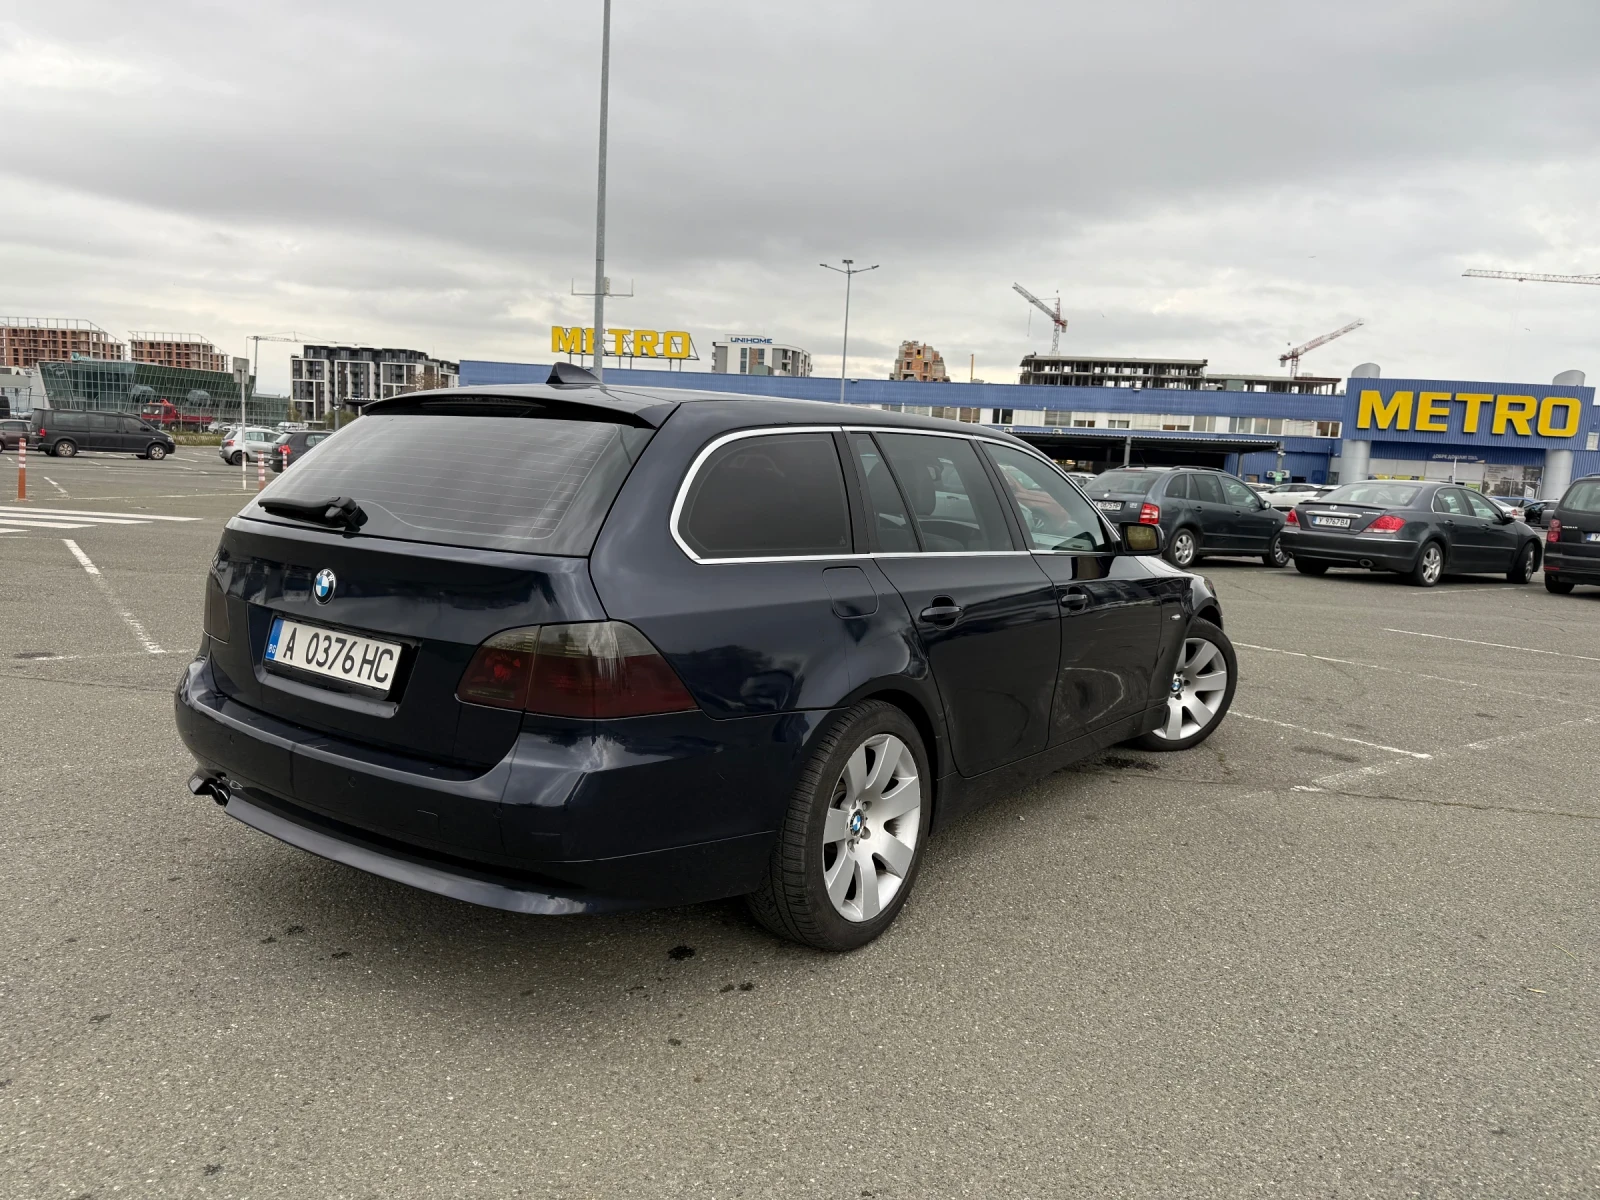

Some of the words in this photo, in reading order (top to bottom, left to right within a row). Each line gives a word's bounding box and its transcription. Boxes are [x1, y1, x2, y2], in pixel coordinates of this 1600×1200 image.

[552, 326, 690, 359] METRO
[1357, 389, 1581, 437] METRO
[283, 627, 297, 660] A
